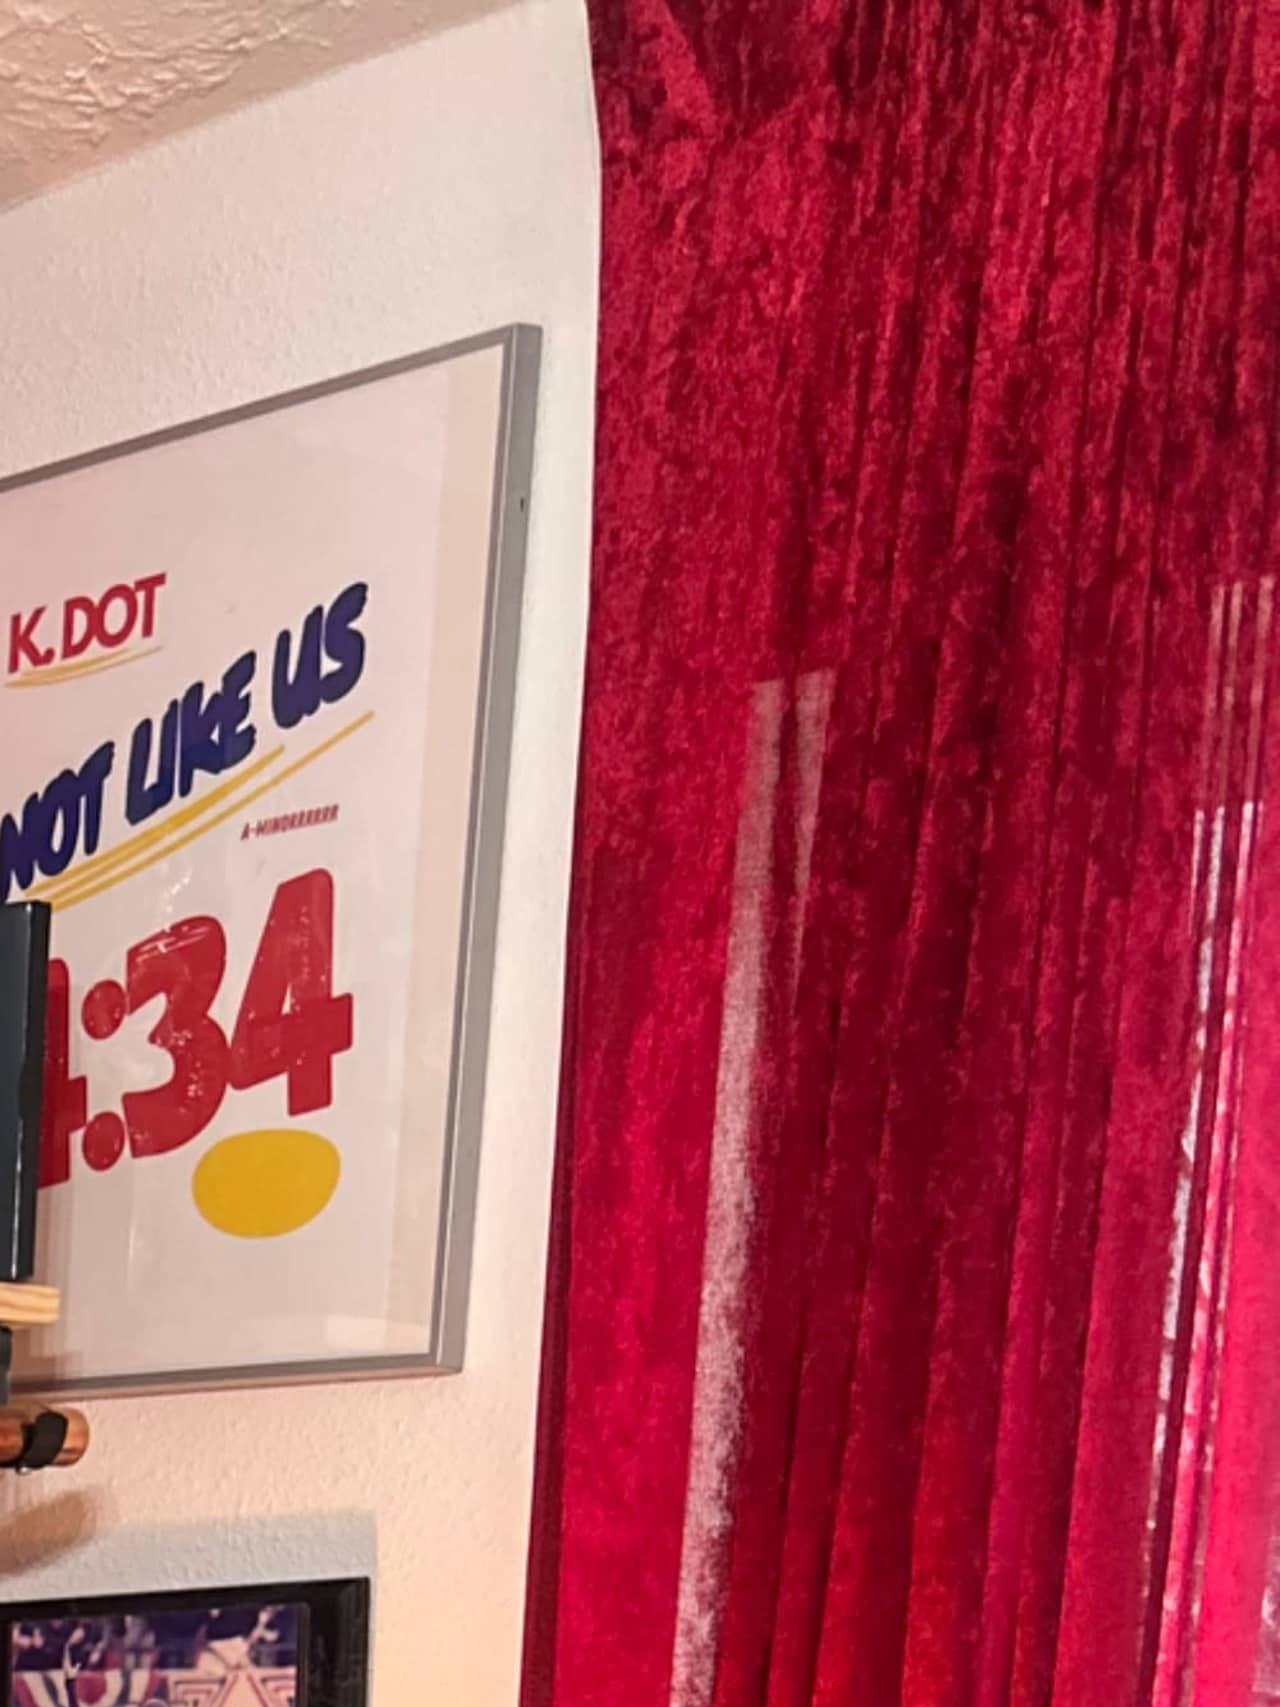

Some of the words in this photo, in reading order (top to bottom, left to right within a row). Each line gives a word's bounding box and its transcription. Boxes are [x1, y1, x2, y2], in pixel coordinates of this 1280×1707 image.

[6, 571, 167, 674] K.DOT
[125, 650, 257, 828] LIKE
[271, 580, 369, 730] US
